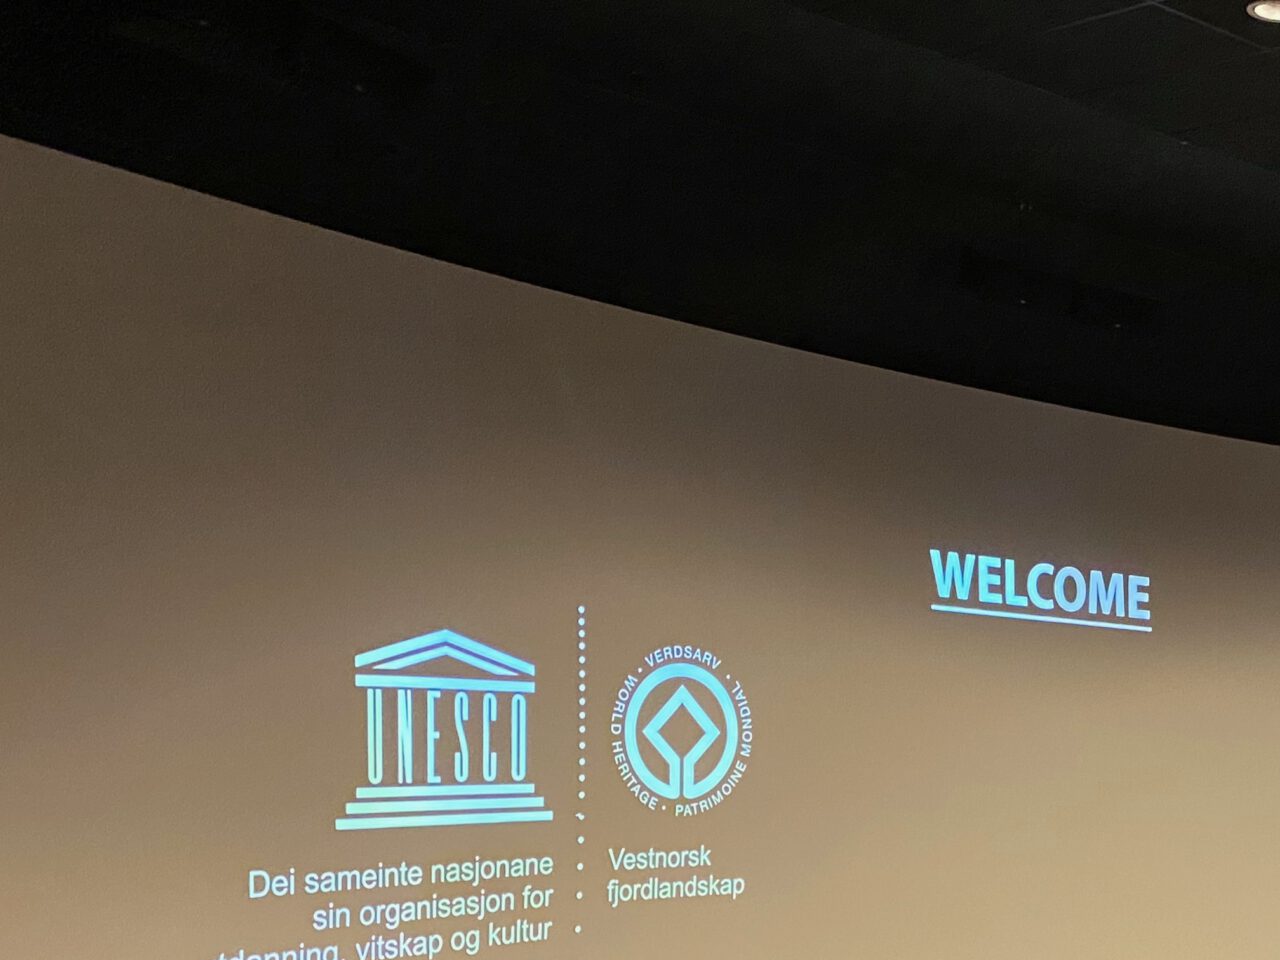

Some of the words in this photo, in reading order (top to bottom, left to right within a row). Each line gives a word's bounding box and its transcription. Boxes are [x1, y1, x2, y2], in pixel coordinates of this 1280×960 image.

[929, 548, 1151, 619] WELCOME
[644, 645, 722, 669] VERDSARV
[610, 674, 639, 735] WORLD
[366, 688, 527, 784] UNESCO
[675, 760, 747, 817] PATRIMOINE
[731, 681, 753, 757] MONDIAL
[611, 740, 658, 810] HERITAGE
[248, 867, 295, 899] Dei
[304, 863, 422, 894] sameinte
[431, 854, 553, 886] nasjonane
[609, 845, 711, 870] Vestnorsk
[312, 903, 351, 931] sin
[359, 890, 515, 929] organisasjon
[522, 885, 554, 908] for
[606, 874, 745, 907] fjordlandskap
[451, 930, 480, 955] og
[487, 917, 553, 946] kultur
